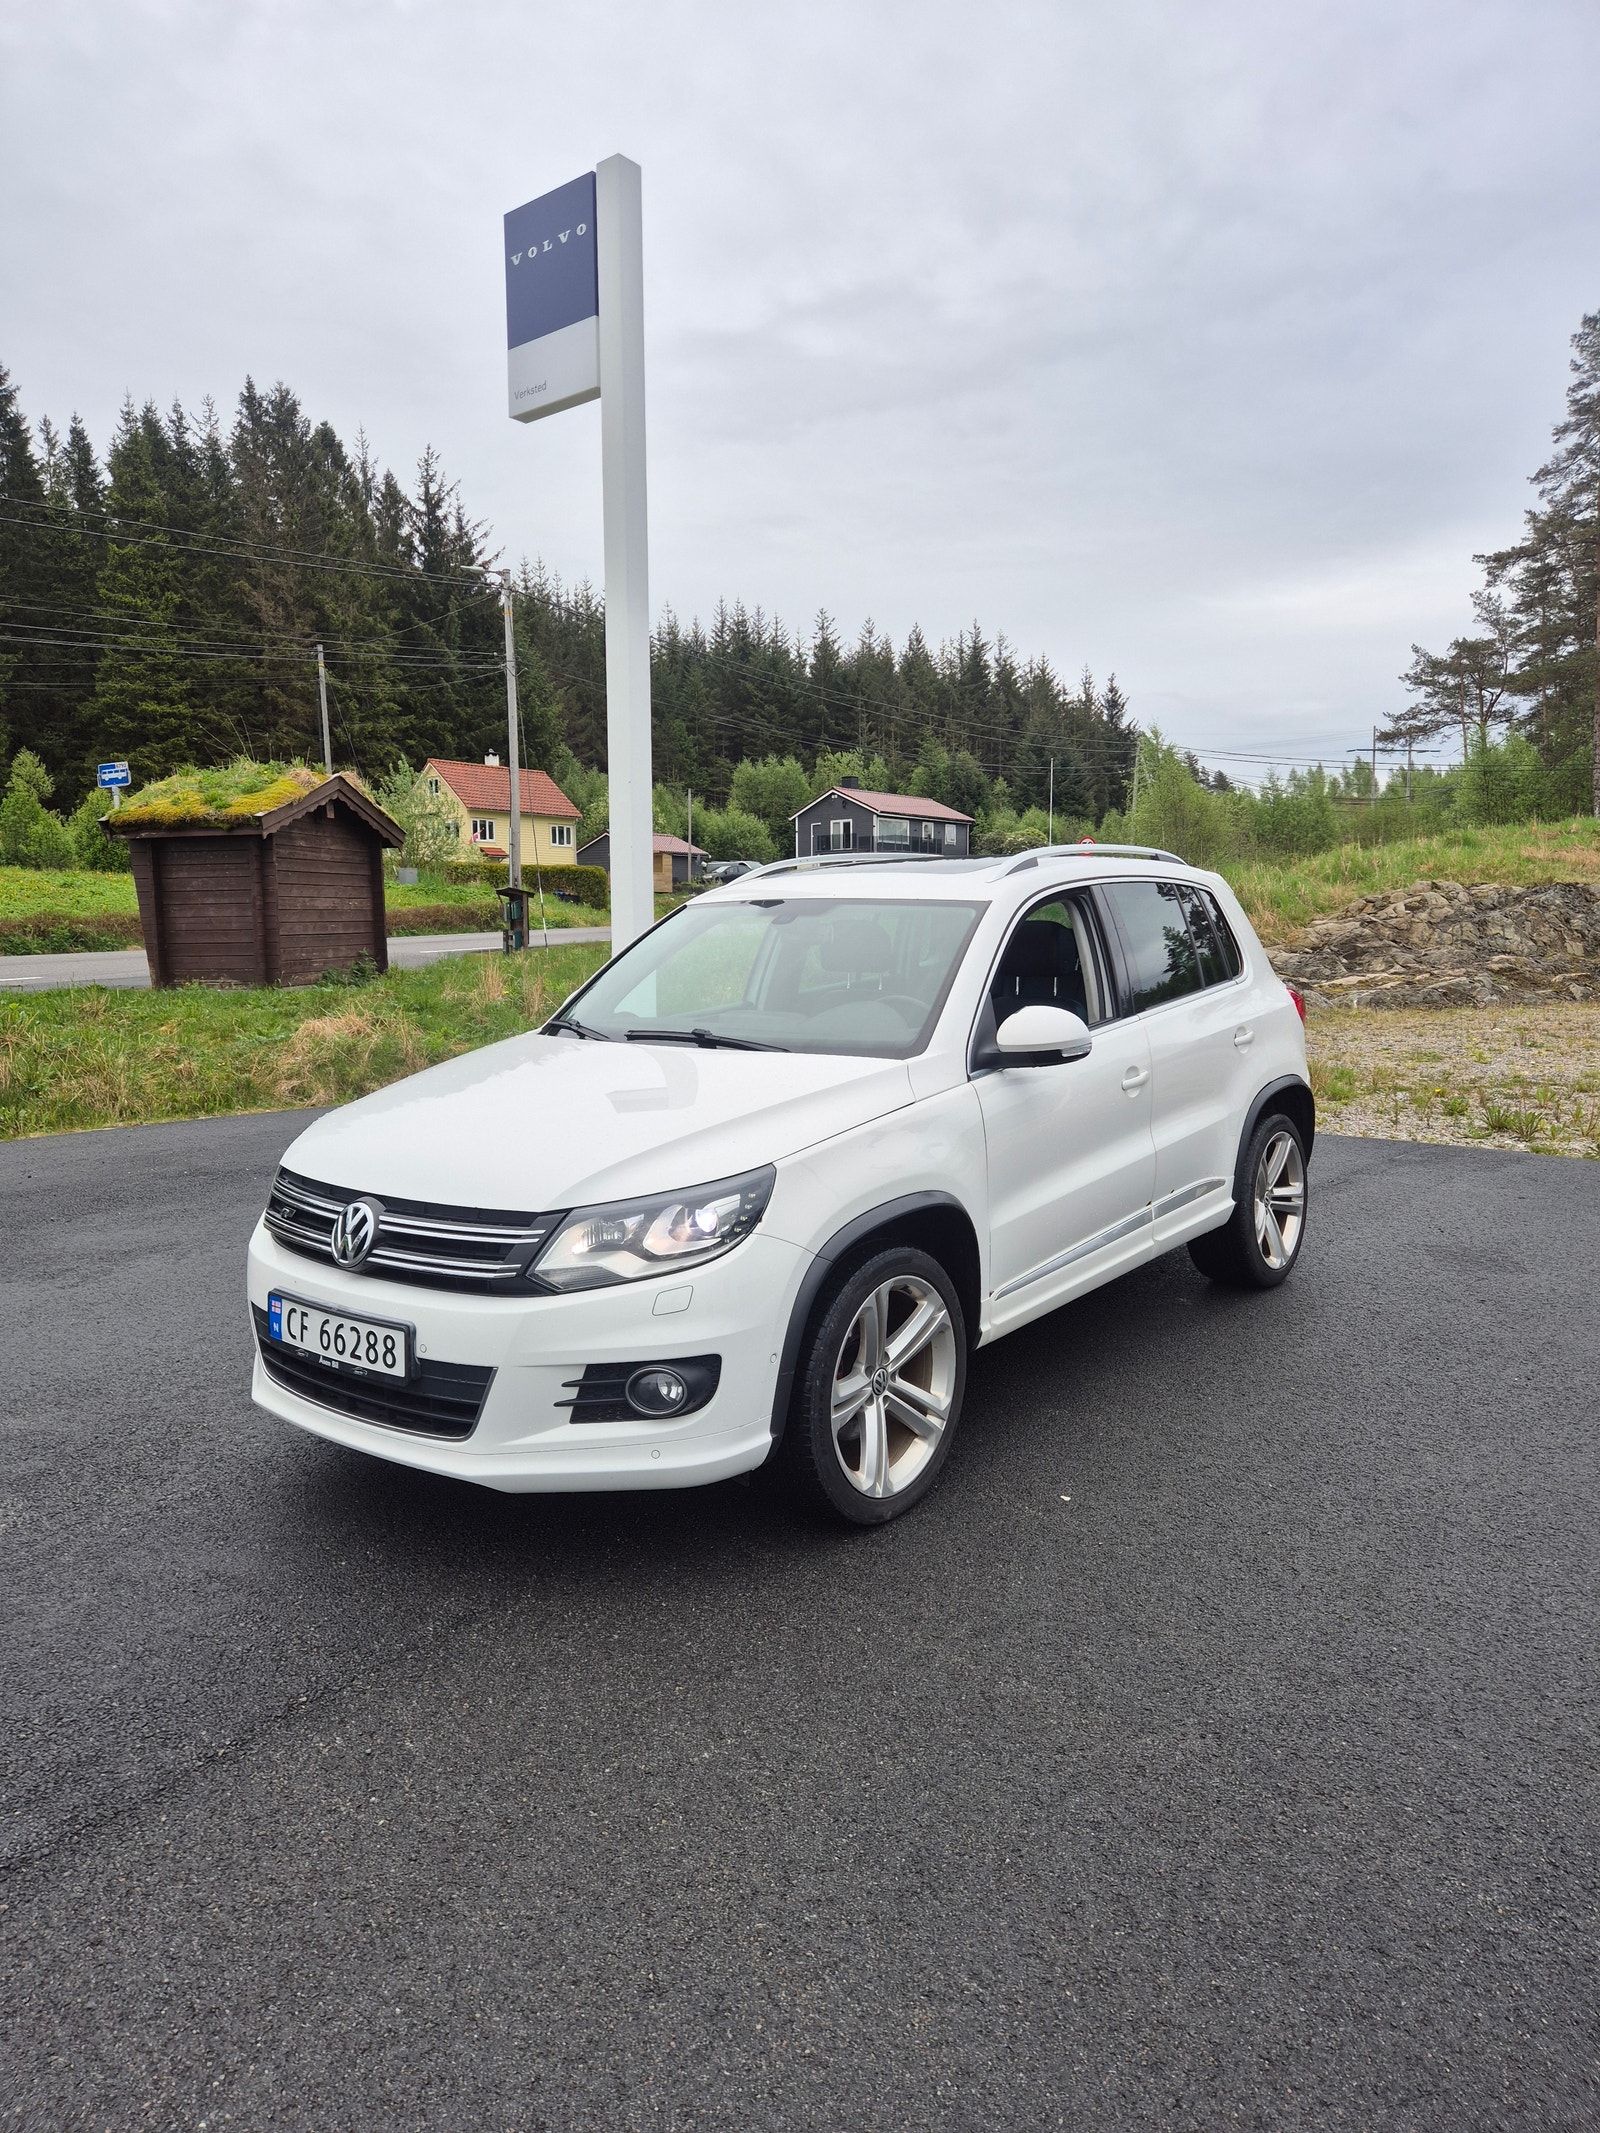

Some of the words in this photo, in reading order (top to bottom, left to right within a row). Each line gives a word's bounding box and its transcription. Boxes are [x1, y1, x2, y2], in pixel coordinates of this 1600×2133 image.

[510, 223, 587, 266] VOLVO
[514, 380, 547, 400] Verksted
[273, 1322, 279, 1333] N
[287, 1307, 309, 1343] CF
[319, 1318, 397, 1369] 66288
